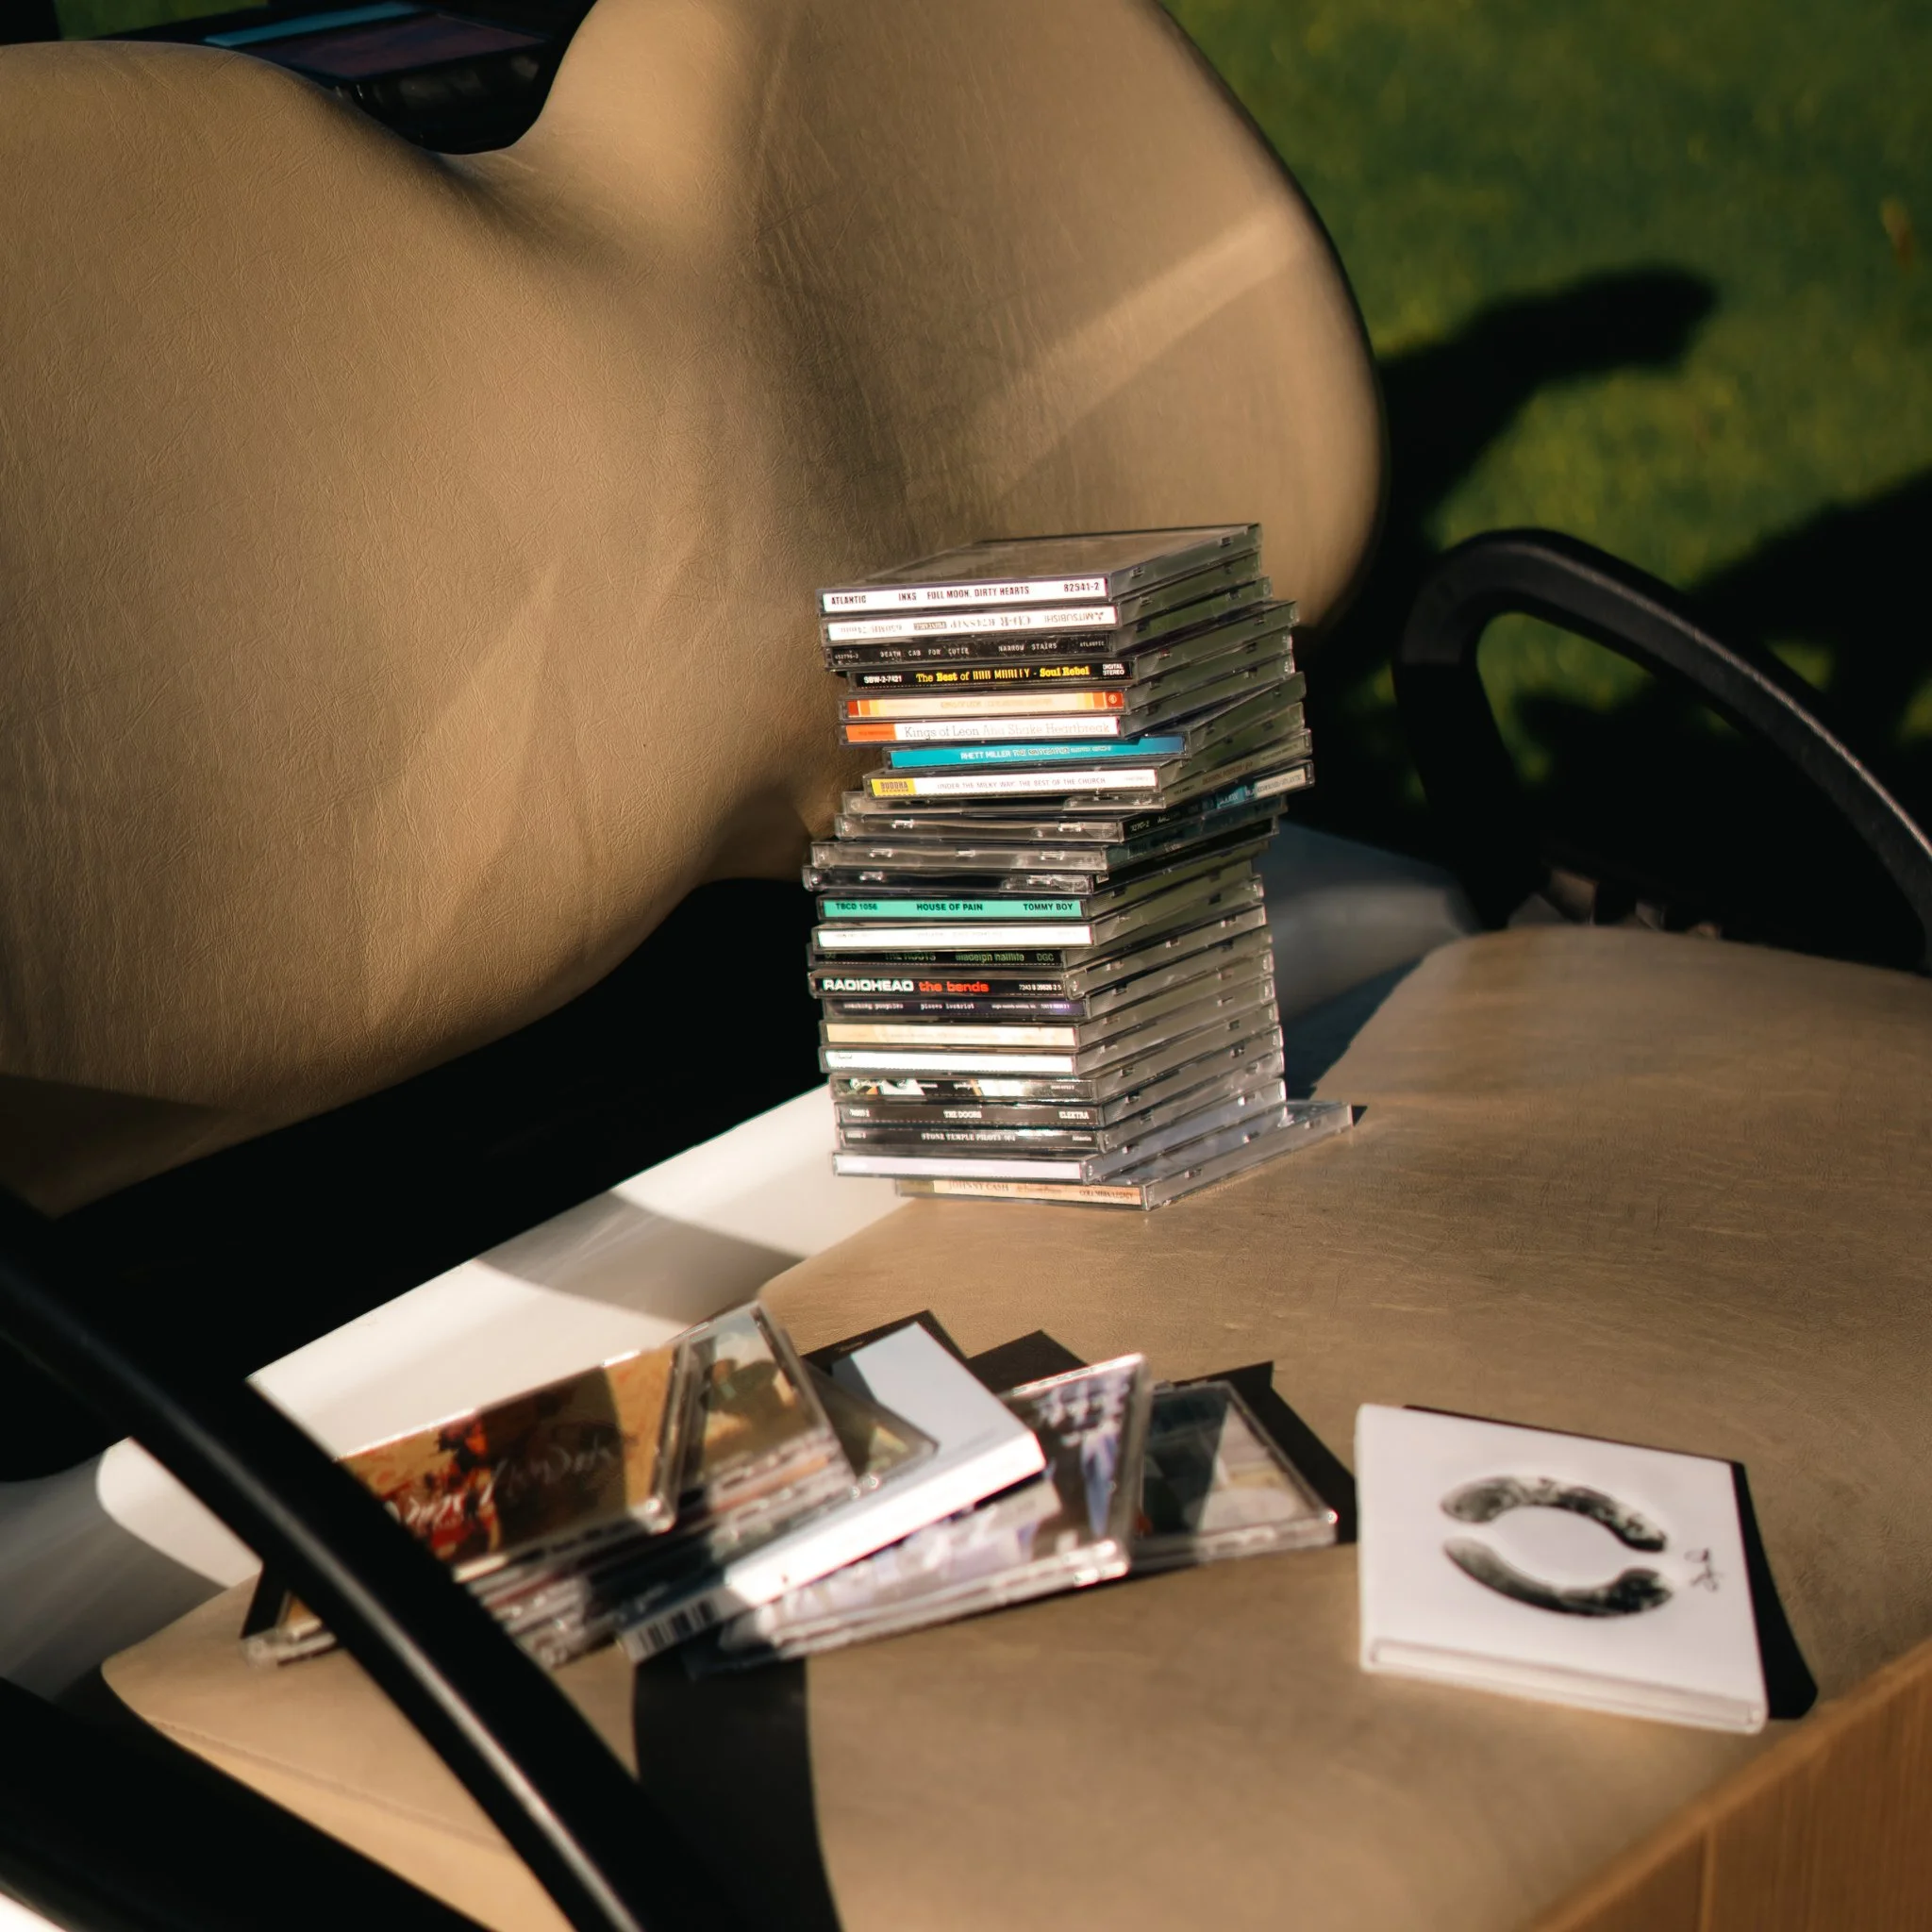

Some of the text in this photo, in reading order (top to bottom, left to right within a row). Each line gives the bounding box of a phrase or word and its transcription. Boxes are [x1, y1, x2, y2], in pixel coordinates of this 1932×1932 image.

[831, 595, 867, 606] ATLANTIC
[898, 592, 917, 602] INXS
[927, 590, 945, 600] FULL
[974, 588, 997, 597] DIRTY
[1000, 586, 1029, 595] HEARTS
[1064, 582, 1099, 592] 82541-2
[1000, 615, 1031, 626] CD-R
[1044, 612, 1094, 623] MITSUBISHI
[948, 647, 969, 656] CUTIE
[998, 643, 1024, 652] NARROW
[1031, 641, 1058, 650] STAIRS
[863, 675, 903, 684] SBW-2-7421
[916, 674, 934, 683] The
[936, 672, 958, 681] Best
[959, 671, 970, 681] of
[1040, 667, 1061, 677] Soul
[1062, 666, 1091, 676] Rebel
[905, 725, 935, 741] Kings
[939, 725, 950, 737] of
[953, 724, 980, 736] Leon
[983, 724, 1005, 735] Aha
[1008, 723, 1042, 735] Shake
[1045, 722, 1109, 734] Heartbreak
[960, 751, 984, 760] RHETT
[985, 749, 1011, 758] MILLER
[916, 903, 947, 911] HOUSE
[948, 903, 960, 911] OF
[962, 903, 983, 911] PAIN
[1023, 903, 1054, 911] TOMMY
[1056, 903, 1074, 911] BOY
[1036, 953, 1055, 961] DGC
[823, 979, 914, 991] RADIOHEAD
[918, 981, 943, 991] the
[946, 981, 990, 992] bends
[958, 1110, 983, 1119] DOORS
[1058, 1110, 1090, 1120] ELEKTRA
[946, 1133, 975, 1141] TEMPLE
[976, 1133, 1002, 1141] PILOTS
[948, 1180, 984, 1191] JOHNNY
[986, 1182, 1009, 1191] CASH
